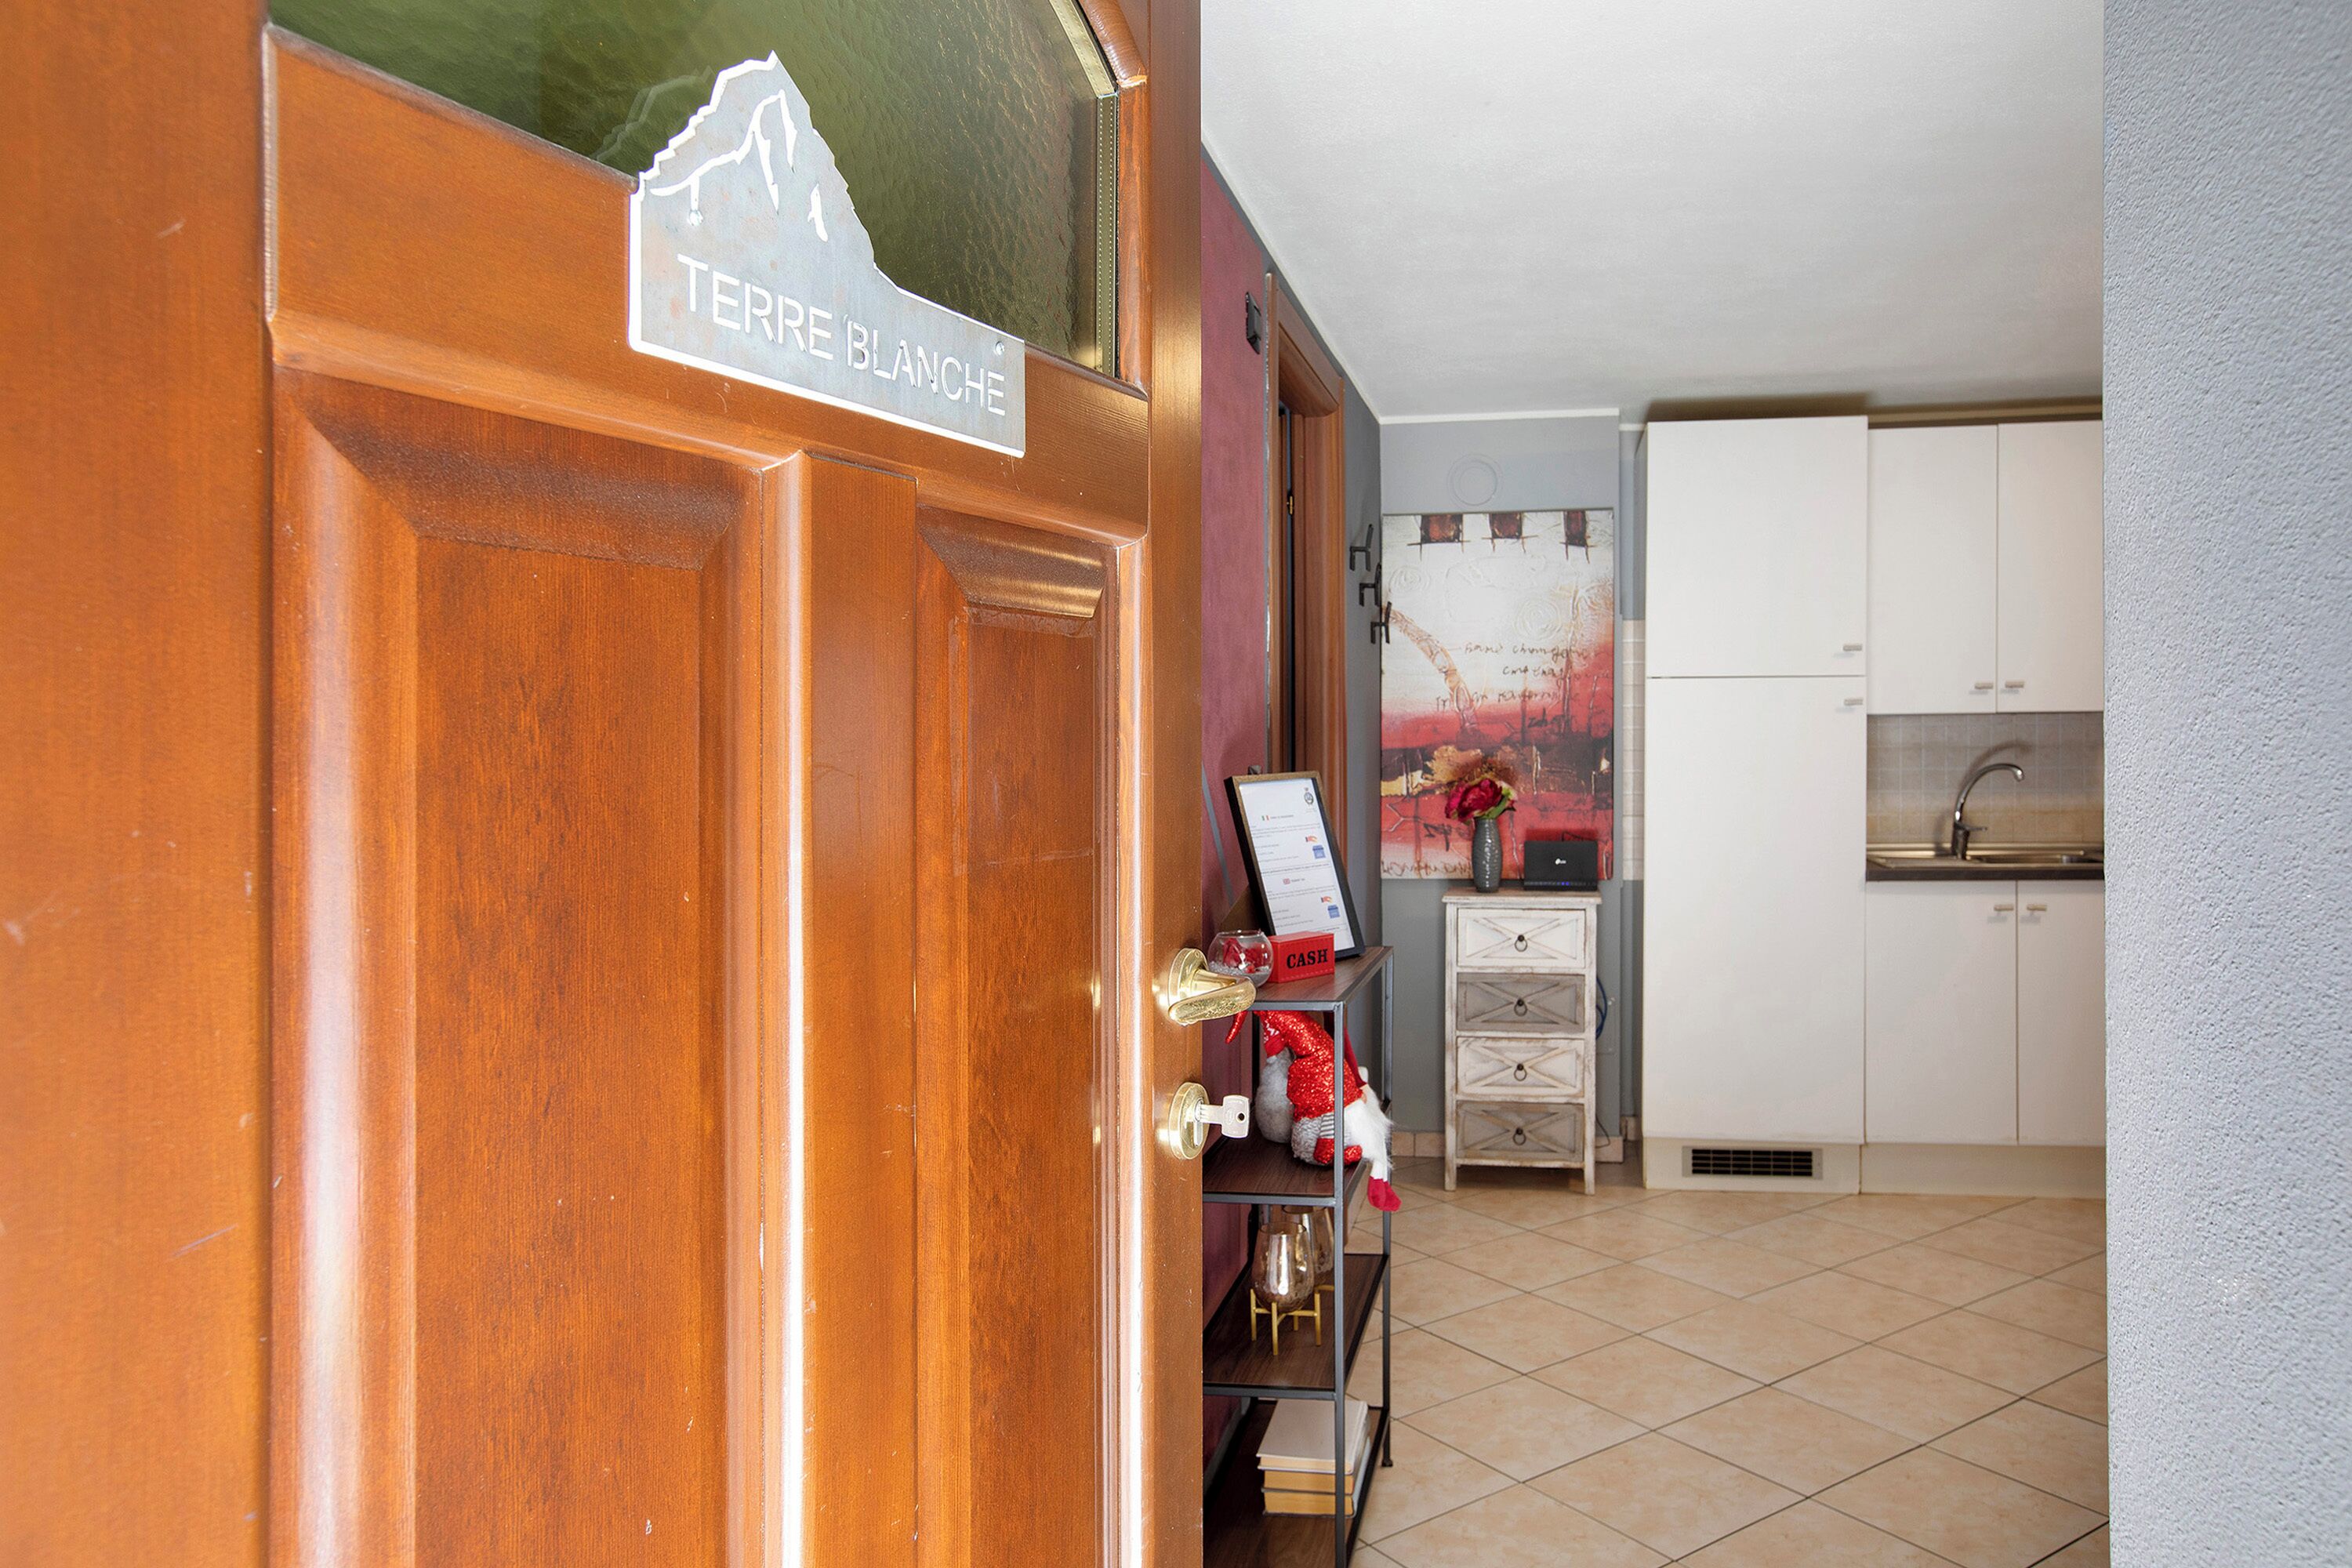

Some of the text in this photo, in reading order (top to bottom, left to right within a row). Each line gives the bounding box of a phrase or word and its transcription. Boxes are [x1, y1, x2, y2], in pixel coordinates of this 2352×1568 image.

[677, 253, 1006, 416] TERRE BLANCHE
[1287, 949, 1328, 969] CASH
